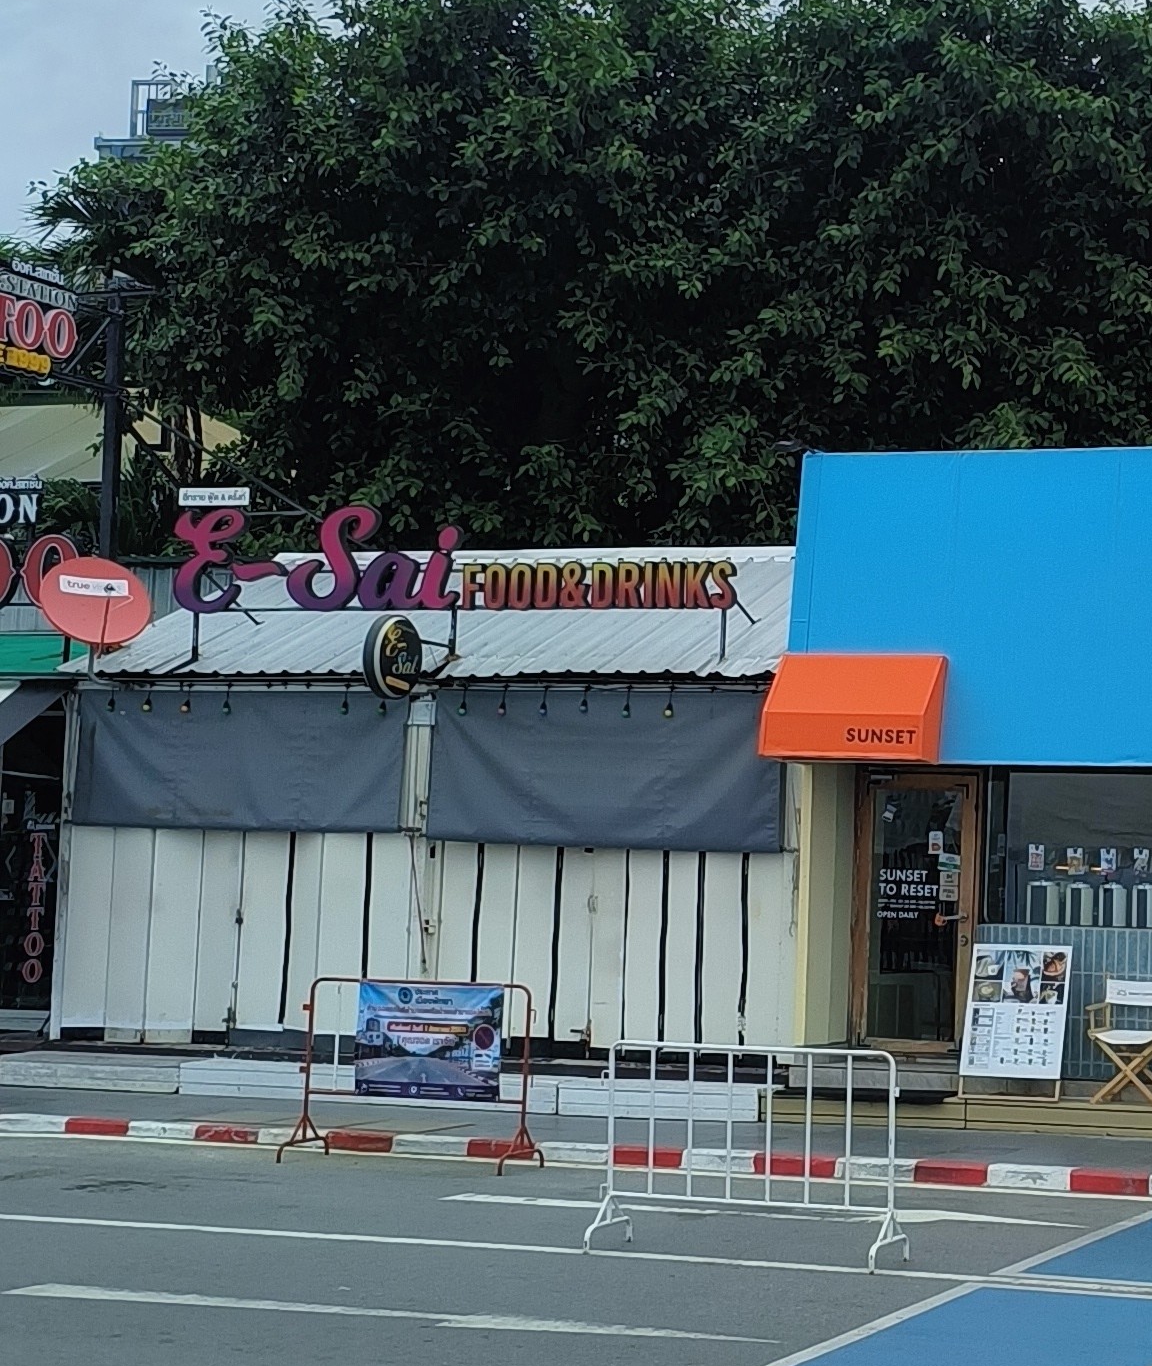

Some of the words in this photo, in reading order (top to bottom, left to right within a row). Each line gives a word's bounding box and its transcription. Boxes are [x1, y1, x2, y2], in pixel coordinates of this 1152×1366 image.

[5, 274, 79, 312] STATION
[67, 580, 91, 590] true
[846, 727, 916, 745] SUNSET
[880, 868, 928, 882] SUNSET
[878, 883, 897, 896] TO
[901, 883, 938, 897] RESET
[876, 910, 897, 919] OPEN
[898, 911, 919, 919] DAILY
